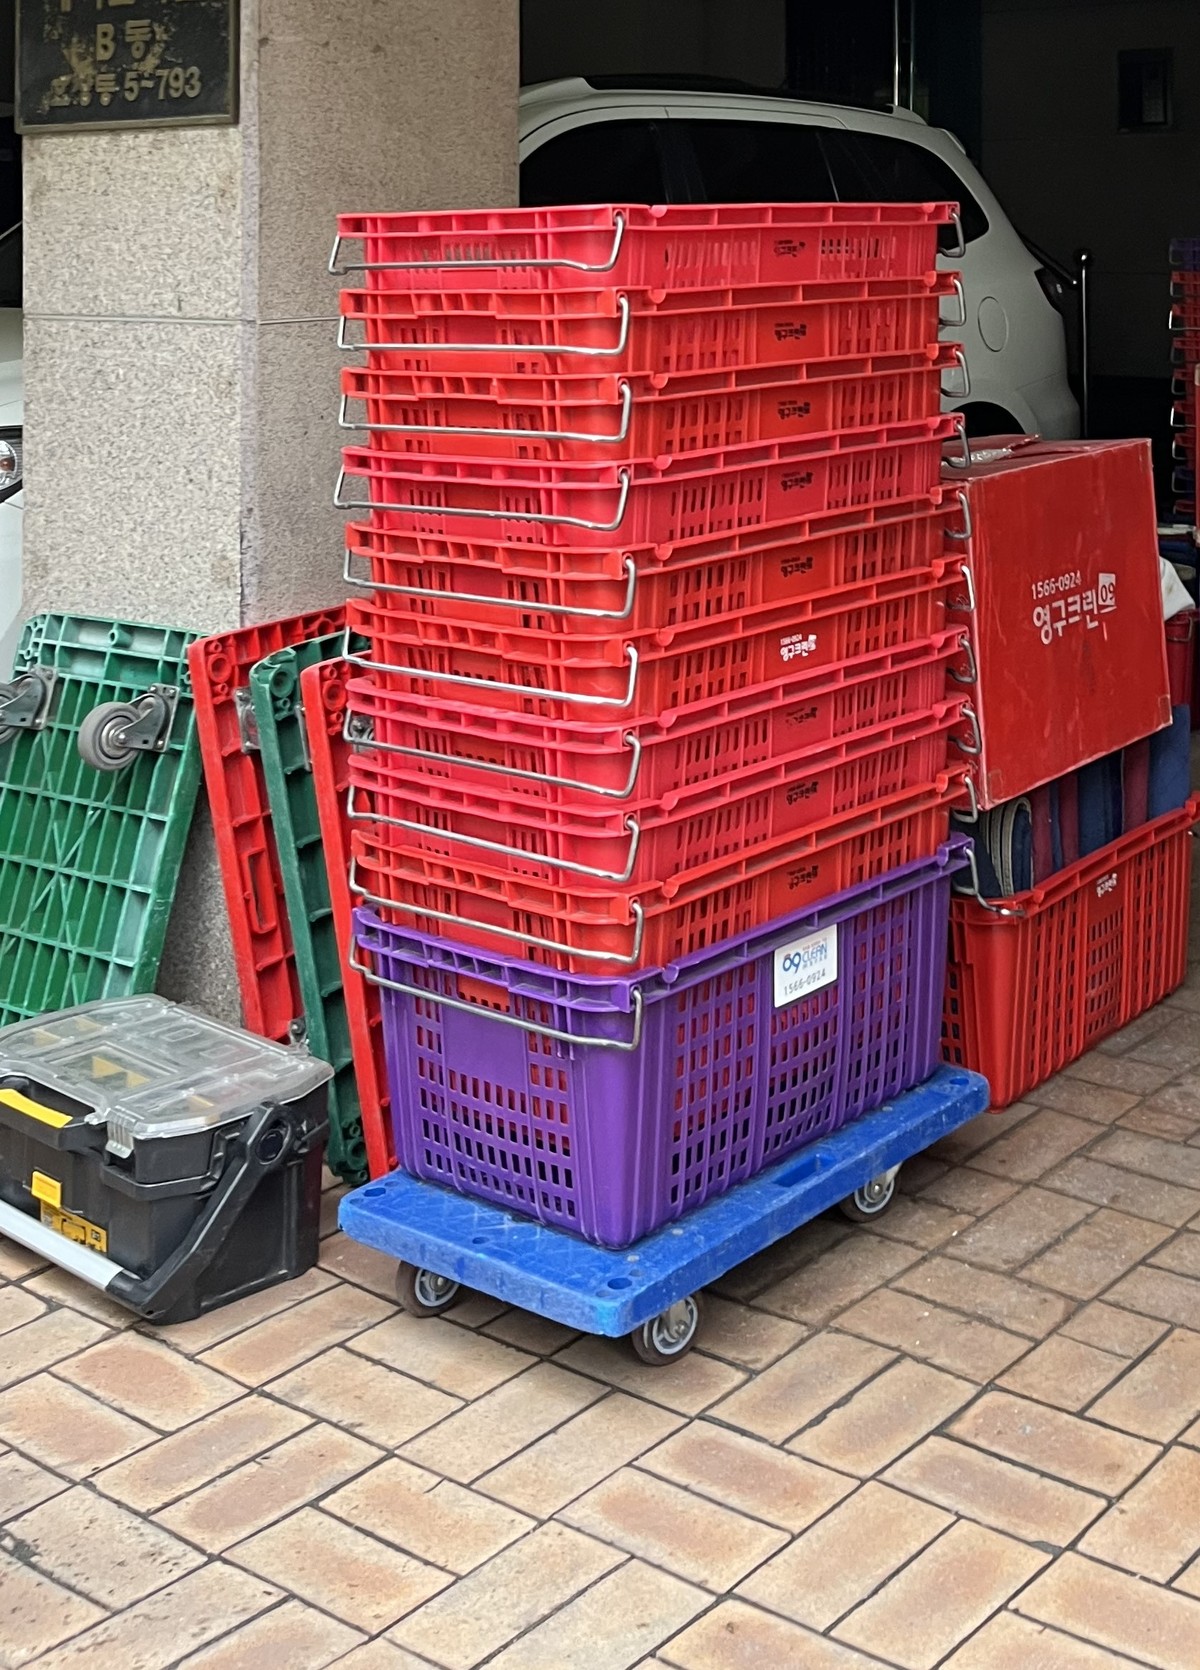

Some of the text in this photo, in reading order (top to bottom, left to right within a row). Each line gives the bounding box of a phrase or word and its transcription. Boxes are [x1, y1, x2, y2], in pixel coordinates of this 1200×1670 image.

[96, 23, 116, 61] B
[123, 66, 201, 101] 5-793
[1031, 570, 1082, 600] 1566-0924
[1033, 589, 1098, 645] 영구크린
[802, 942, 828, 963] CLEAN
[784, 968, 827, 996] 1566-0924
